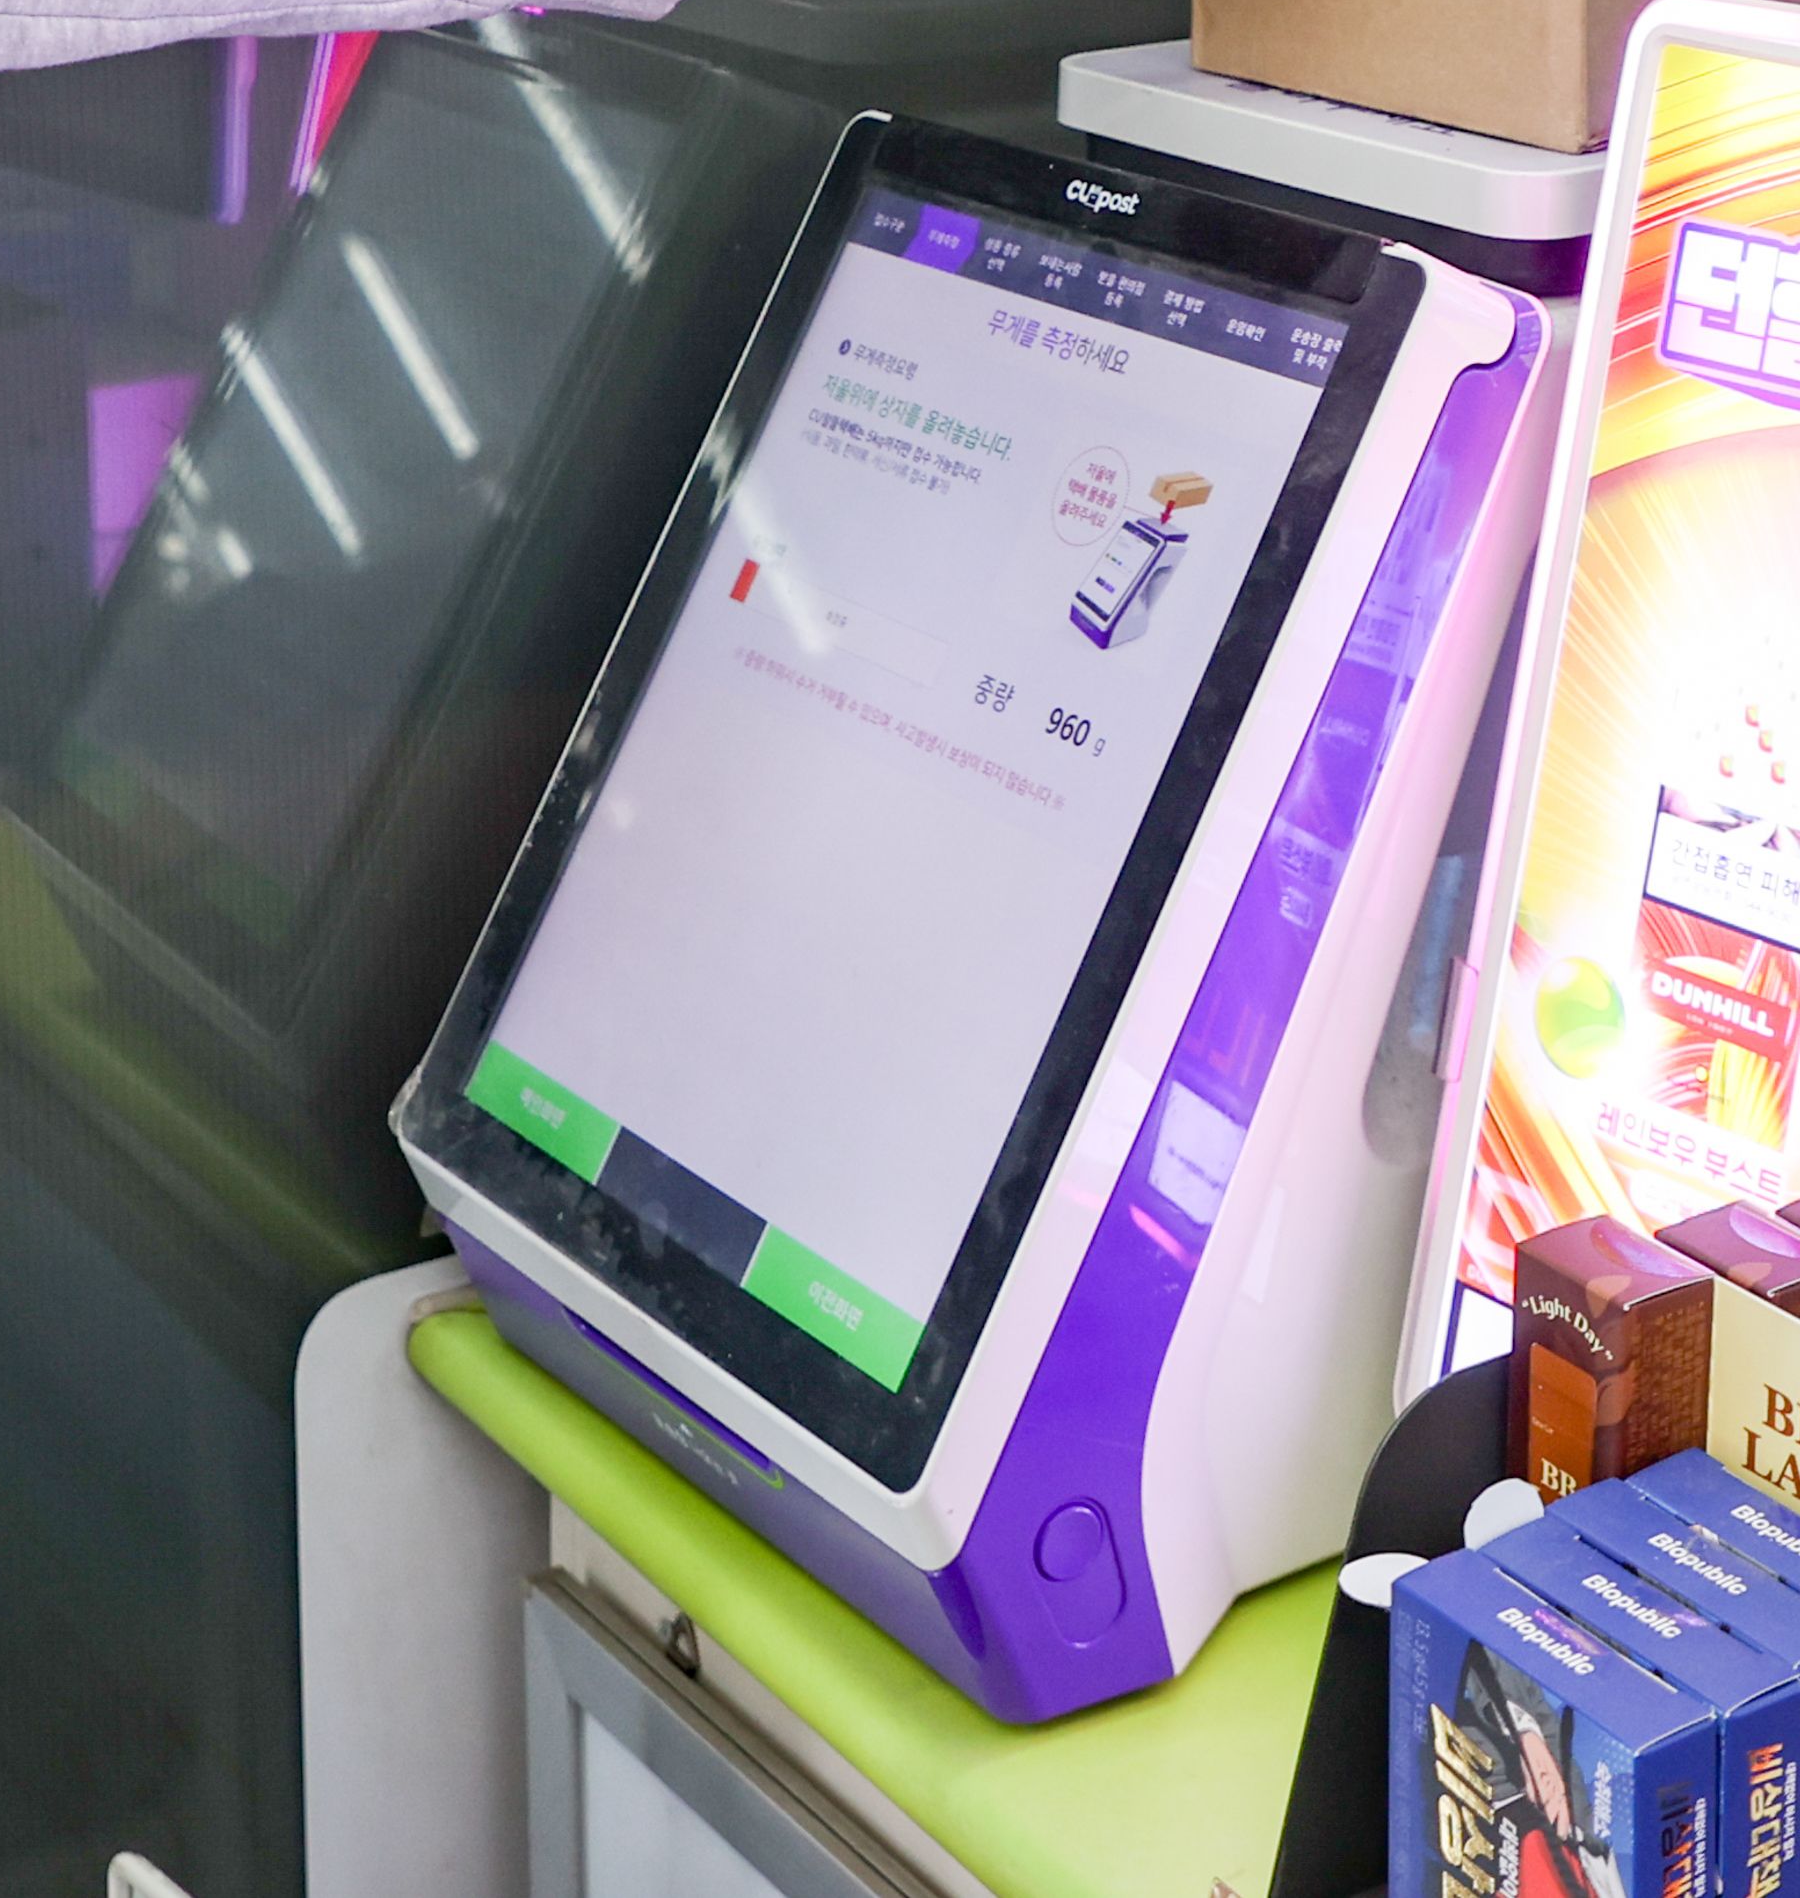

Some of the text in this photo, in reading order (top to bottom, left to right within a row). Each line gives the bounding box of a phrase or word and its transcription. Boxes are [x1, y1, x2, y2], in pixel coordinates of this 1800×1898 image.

[987, 309, 1129, 375] 무게를 측정하세요
[822, 374, 879, 412] 저울위에
[879, 395, 922, 428] 상자를
[974, 674, 1106, 757] 중량 960 g
[1671, 838, 1754, 888] 간접흡연
[1650, 970, 1774, 1038] DUNHILL
[1598, 1102, 1783, 1204] 레인보우 부스트
[1648, 1532, 1747, 1597] Biopublic
[1582, 1573, 1683, 1640] Biopublic
[1497, 1607, 1595, 1677] Biopublic
